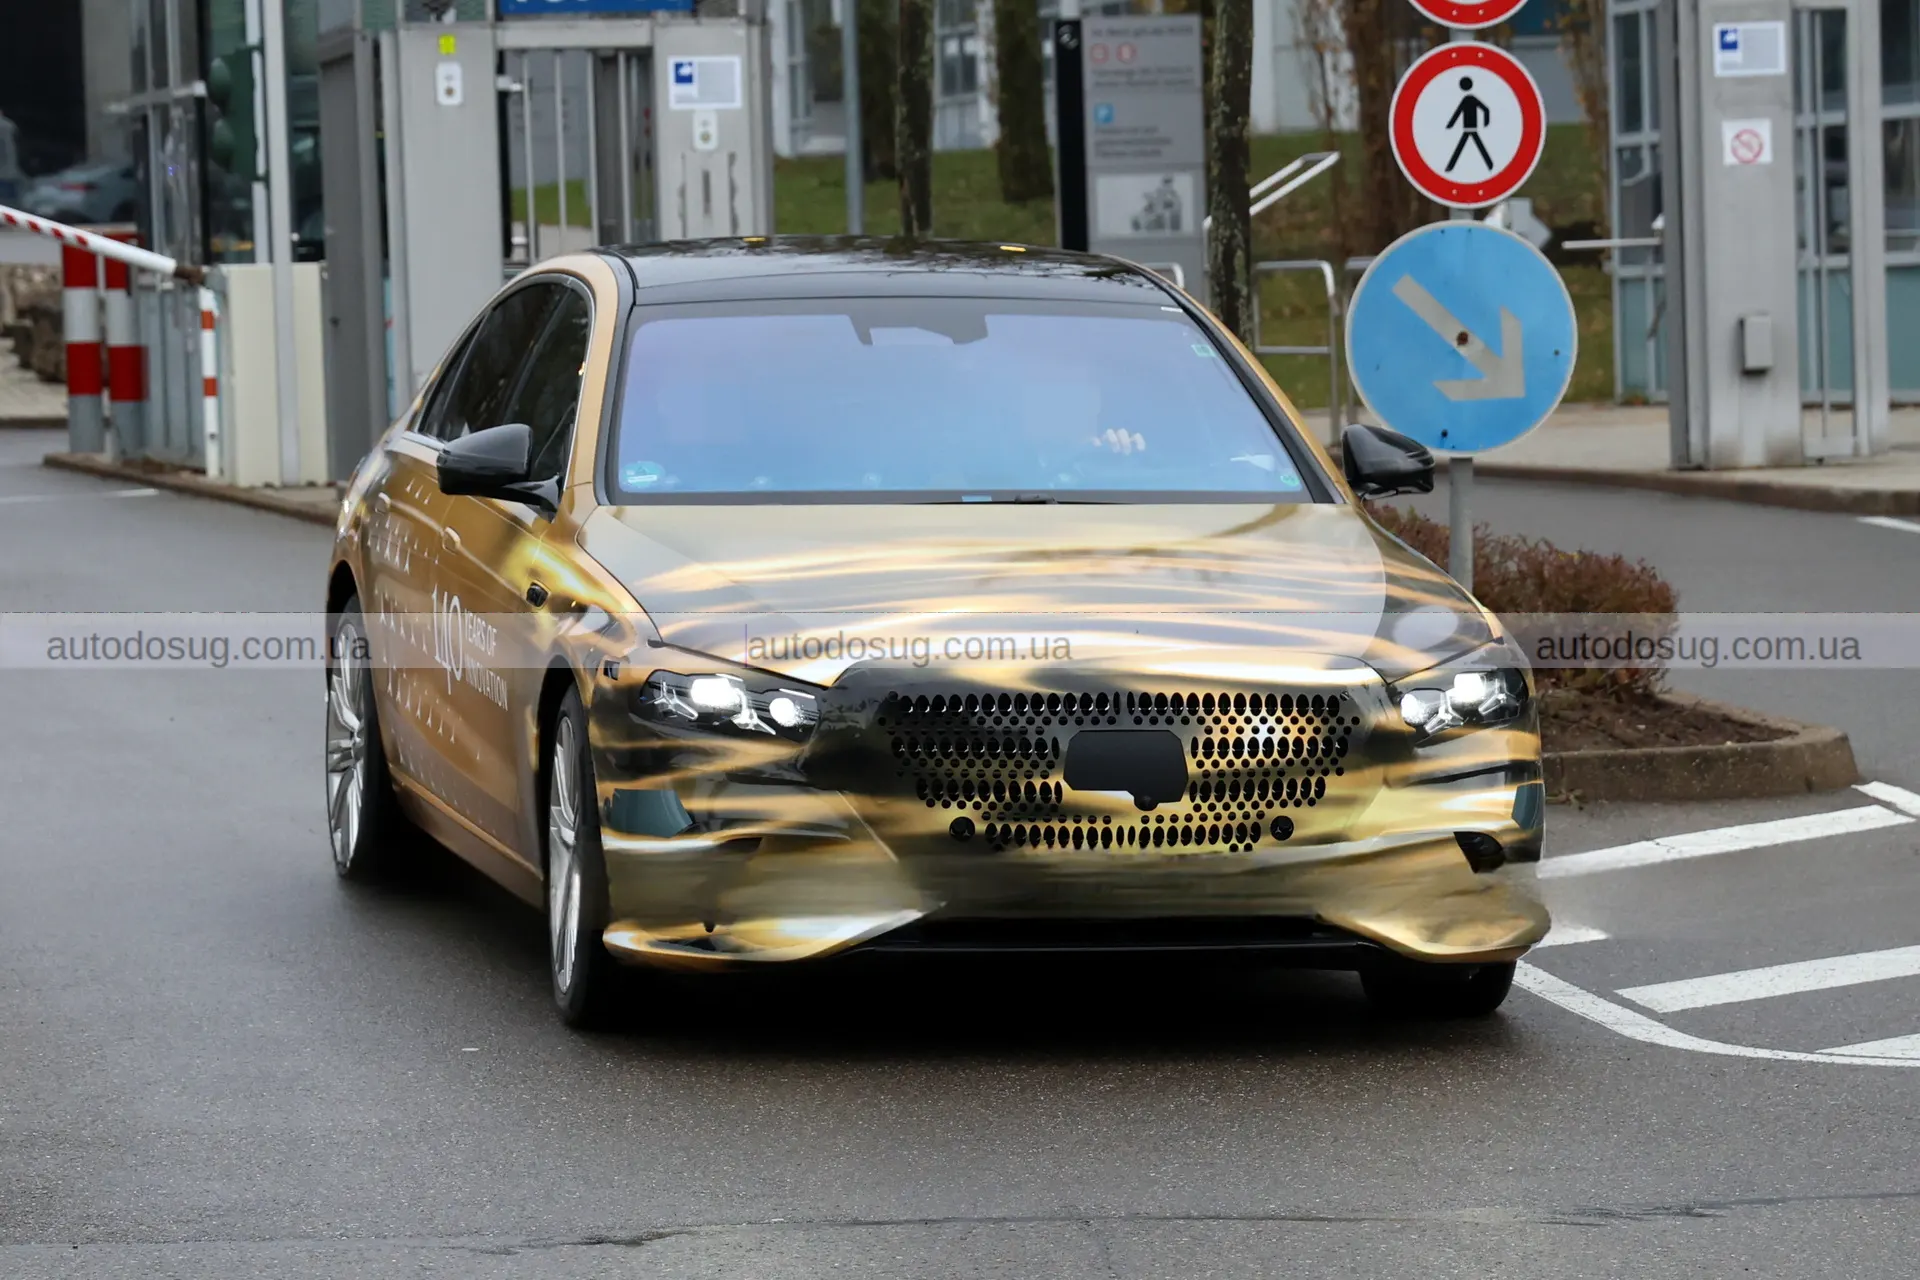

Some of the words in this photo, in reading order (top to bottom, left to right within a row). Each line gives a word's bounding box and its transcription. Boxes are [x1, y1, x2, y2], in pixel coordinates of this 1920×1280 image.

[432, 583, 463, 695] 140
[464, 608, 486, 652] YEARS
[486, 624, 498, 657] OF
[465, 652, 508, 711] INNOVATION
